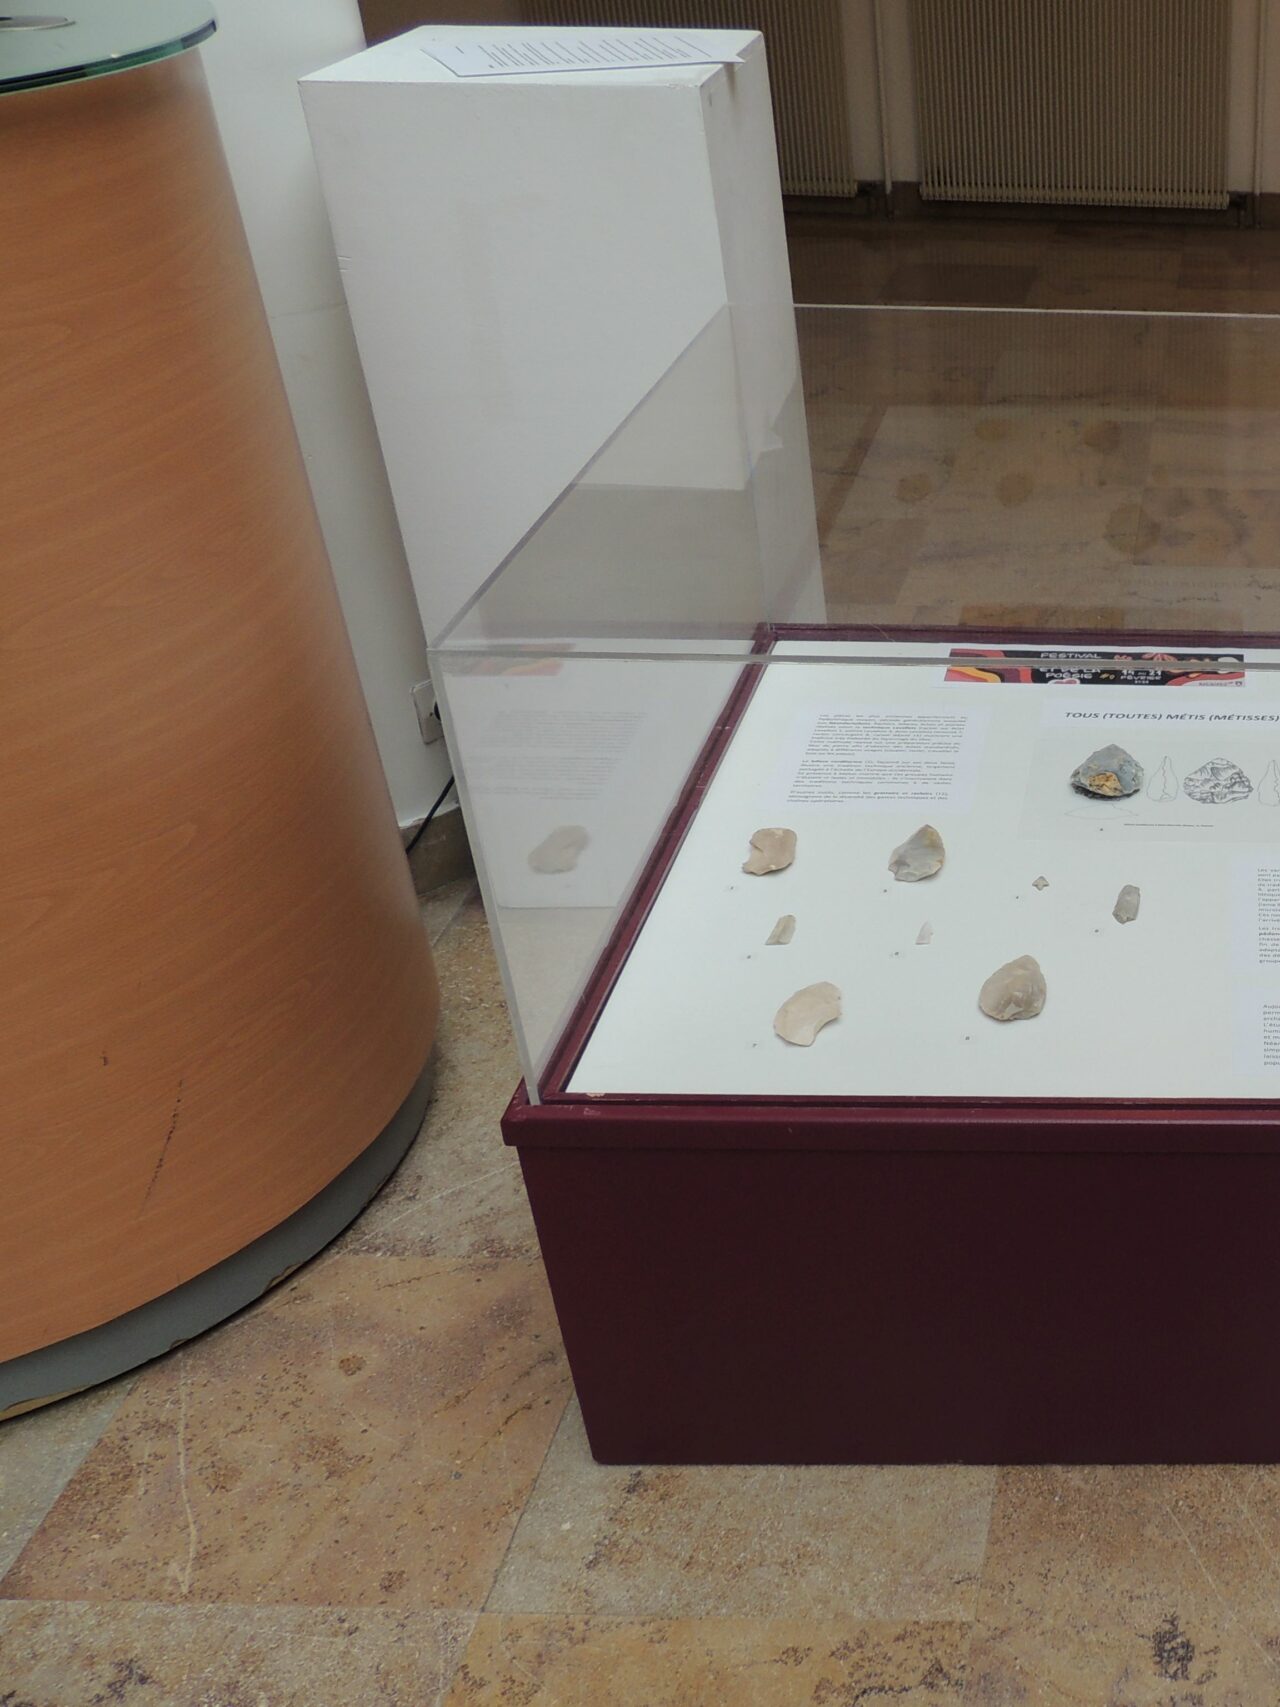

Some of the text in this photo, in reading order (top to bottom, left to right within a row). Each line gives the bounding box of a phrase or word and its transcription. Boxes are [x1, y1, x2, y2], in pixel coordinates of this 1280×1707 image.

[1064, 711, 1099, 719] TOUS
[1102, 712, 1163, 721] (TOUTES)
[1166, 711, 1206, 720] MÉTIS
[1209, 713, 1280, 722] (MÉTISSES)
